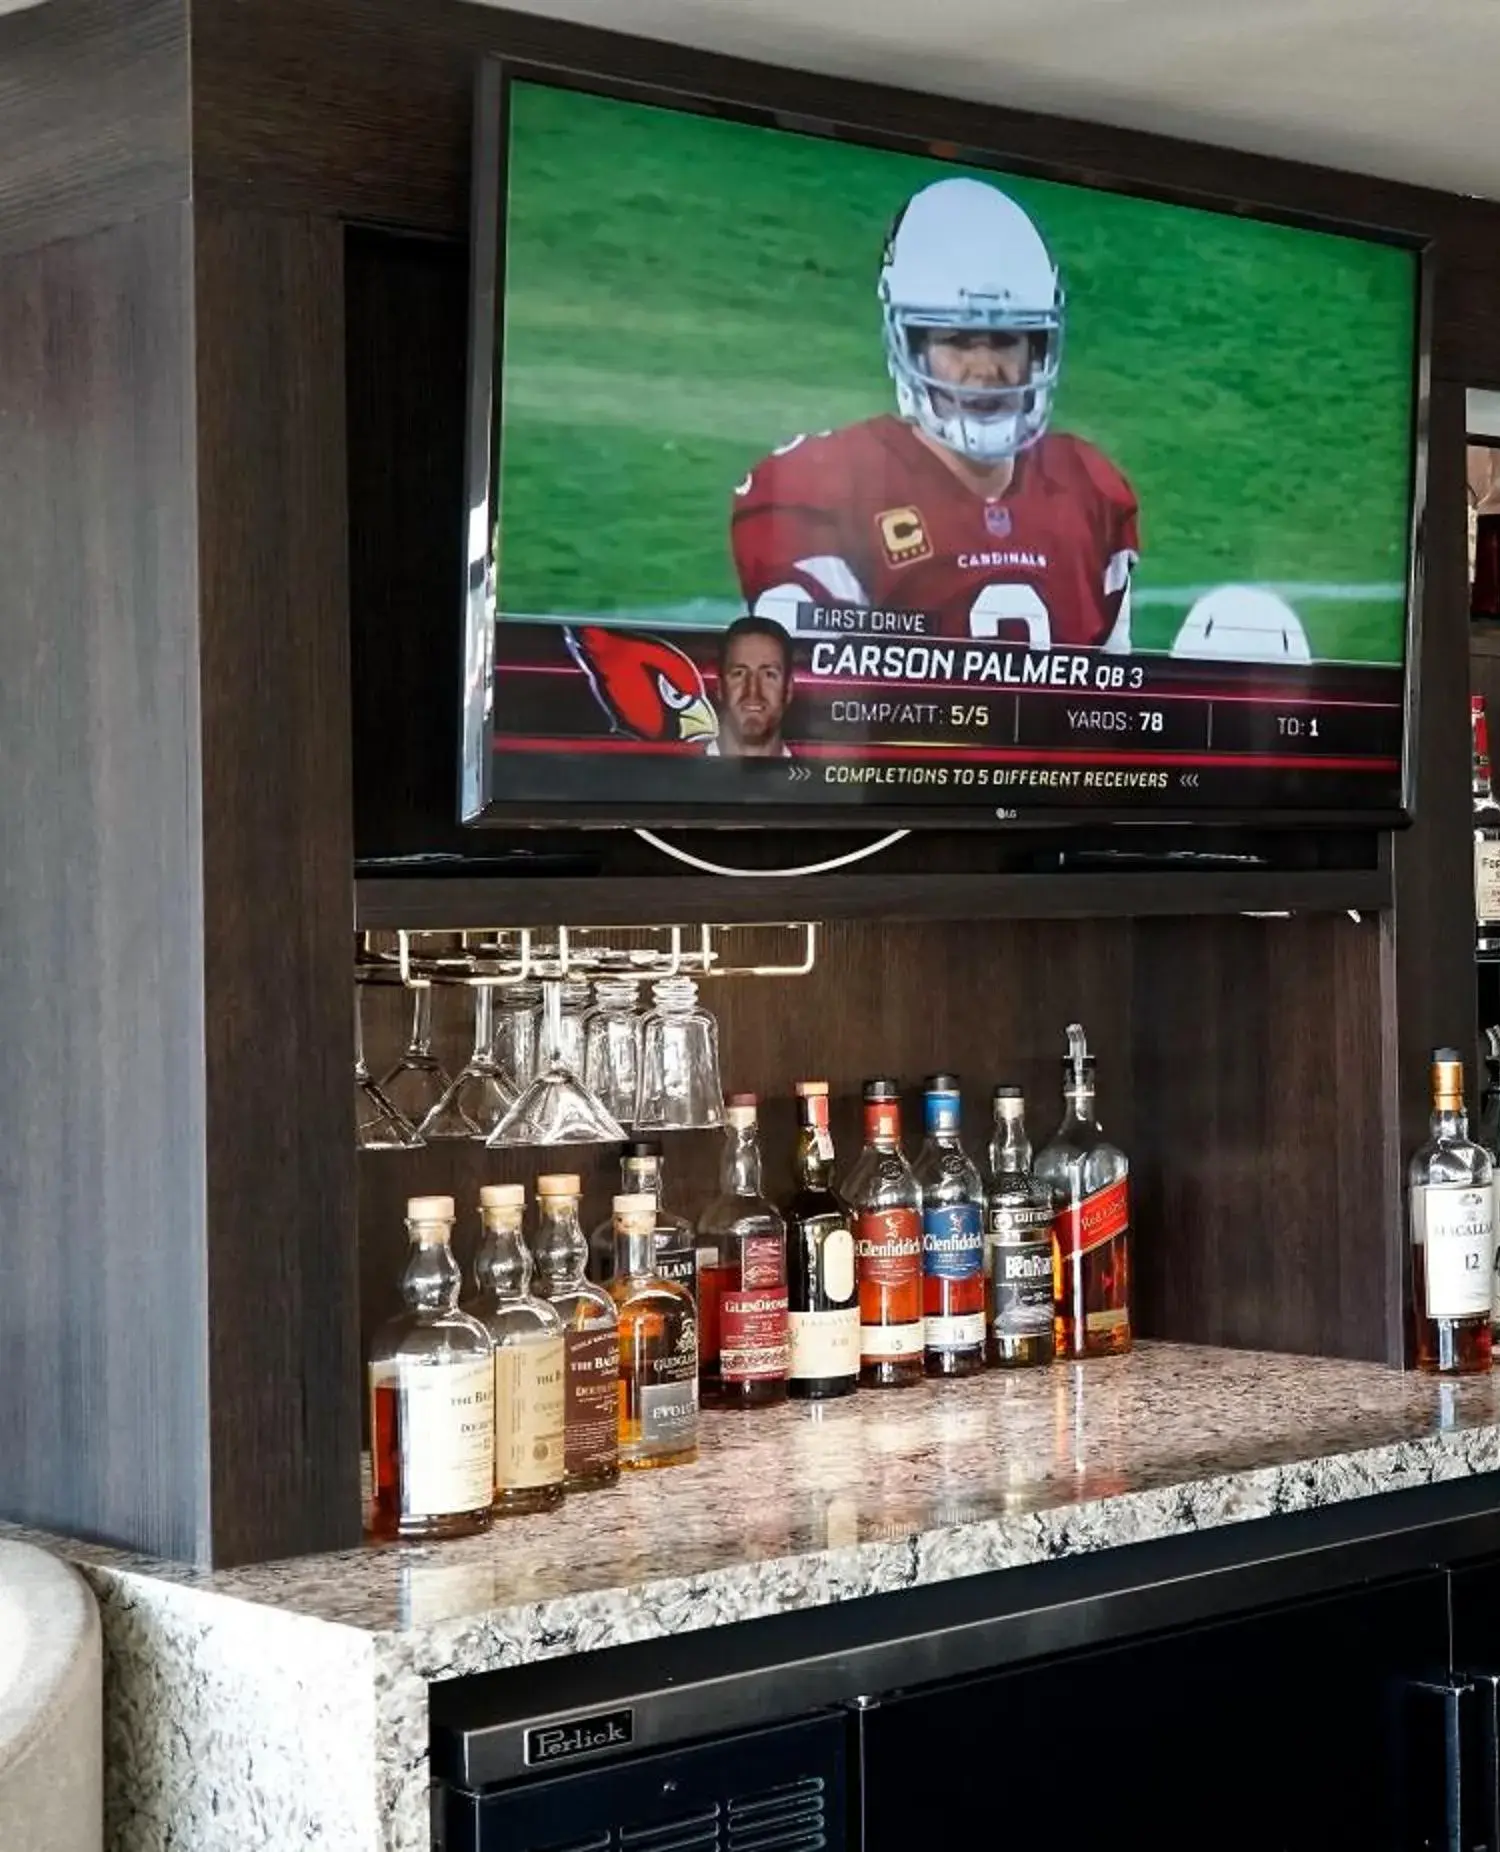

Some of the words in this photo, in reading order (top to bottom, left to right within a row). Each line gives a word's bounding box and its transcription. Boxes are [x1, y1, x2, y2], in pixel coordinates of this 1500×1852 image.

[957, 552, 1047, 568] CARDINALS
[813, 607, 867, 629] FIRST
[871, 611, 926, 633] DRIVE
[810, 643, 954, 679] CARSON
[963, 651, 1089, 686] PALMER
[1094, 665, 1124, 689] QB
[1129, 667, 1144, 688] 3
[831, 700, 944, 725] COMP/ATT:
[951, 707, 990, 727] 5/5
[1066, 710, 1133, 731] YARDS:
[1139, 712, 1164, 732] 78
[1309, 719, 1320, 737] 1
[825, 765, 948, 784] COMPLETIONS
[952, 768, 974, 785] TO
[977, 769, 990, 785] 5
[993, 769, 1080, 787] DIFFERENT
[1084, 771, 1169, 788] RECEIVERS
[1465, 1252, 1480, 1271] 12
[534, 1721, 626, 1759] Perlick
